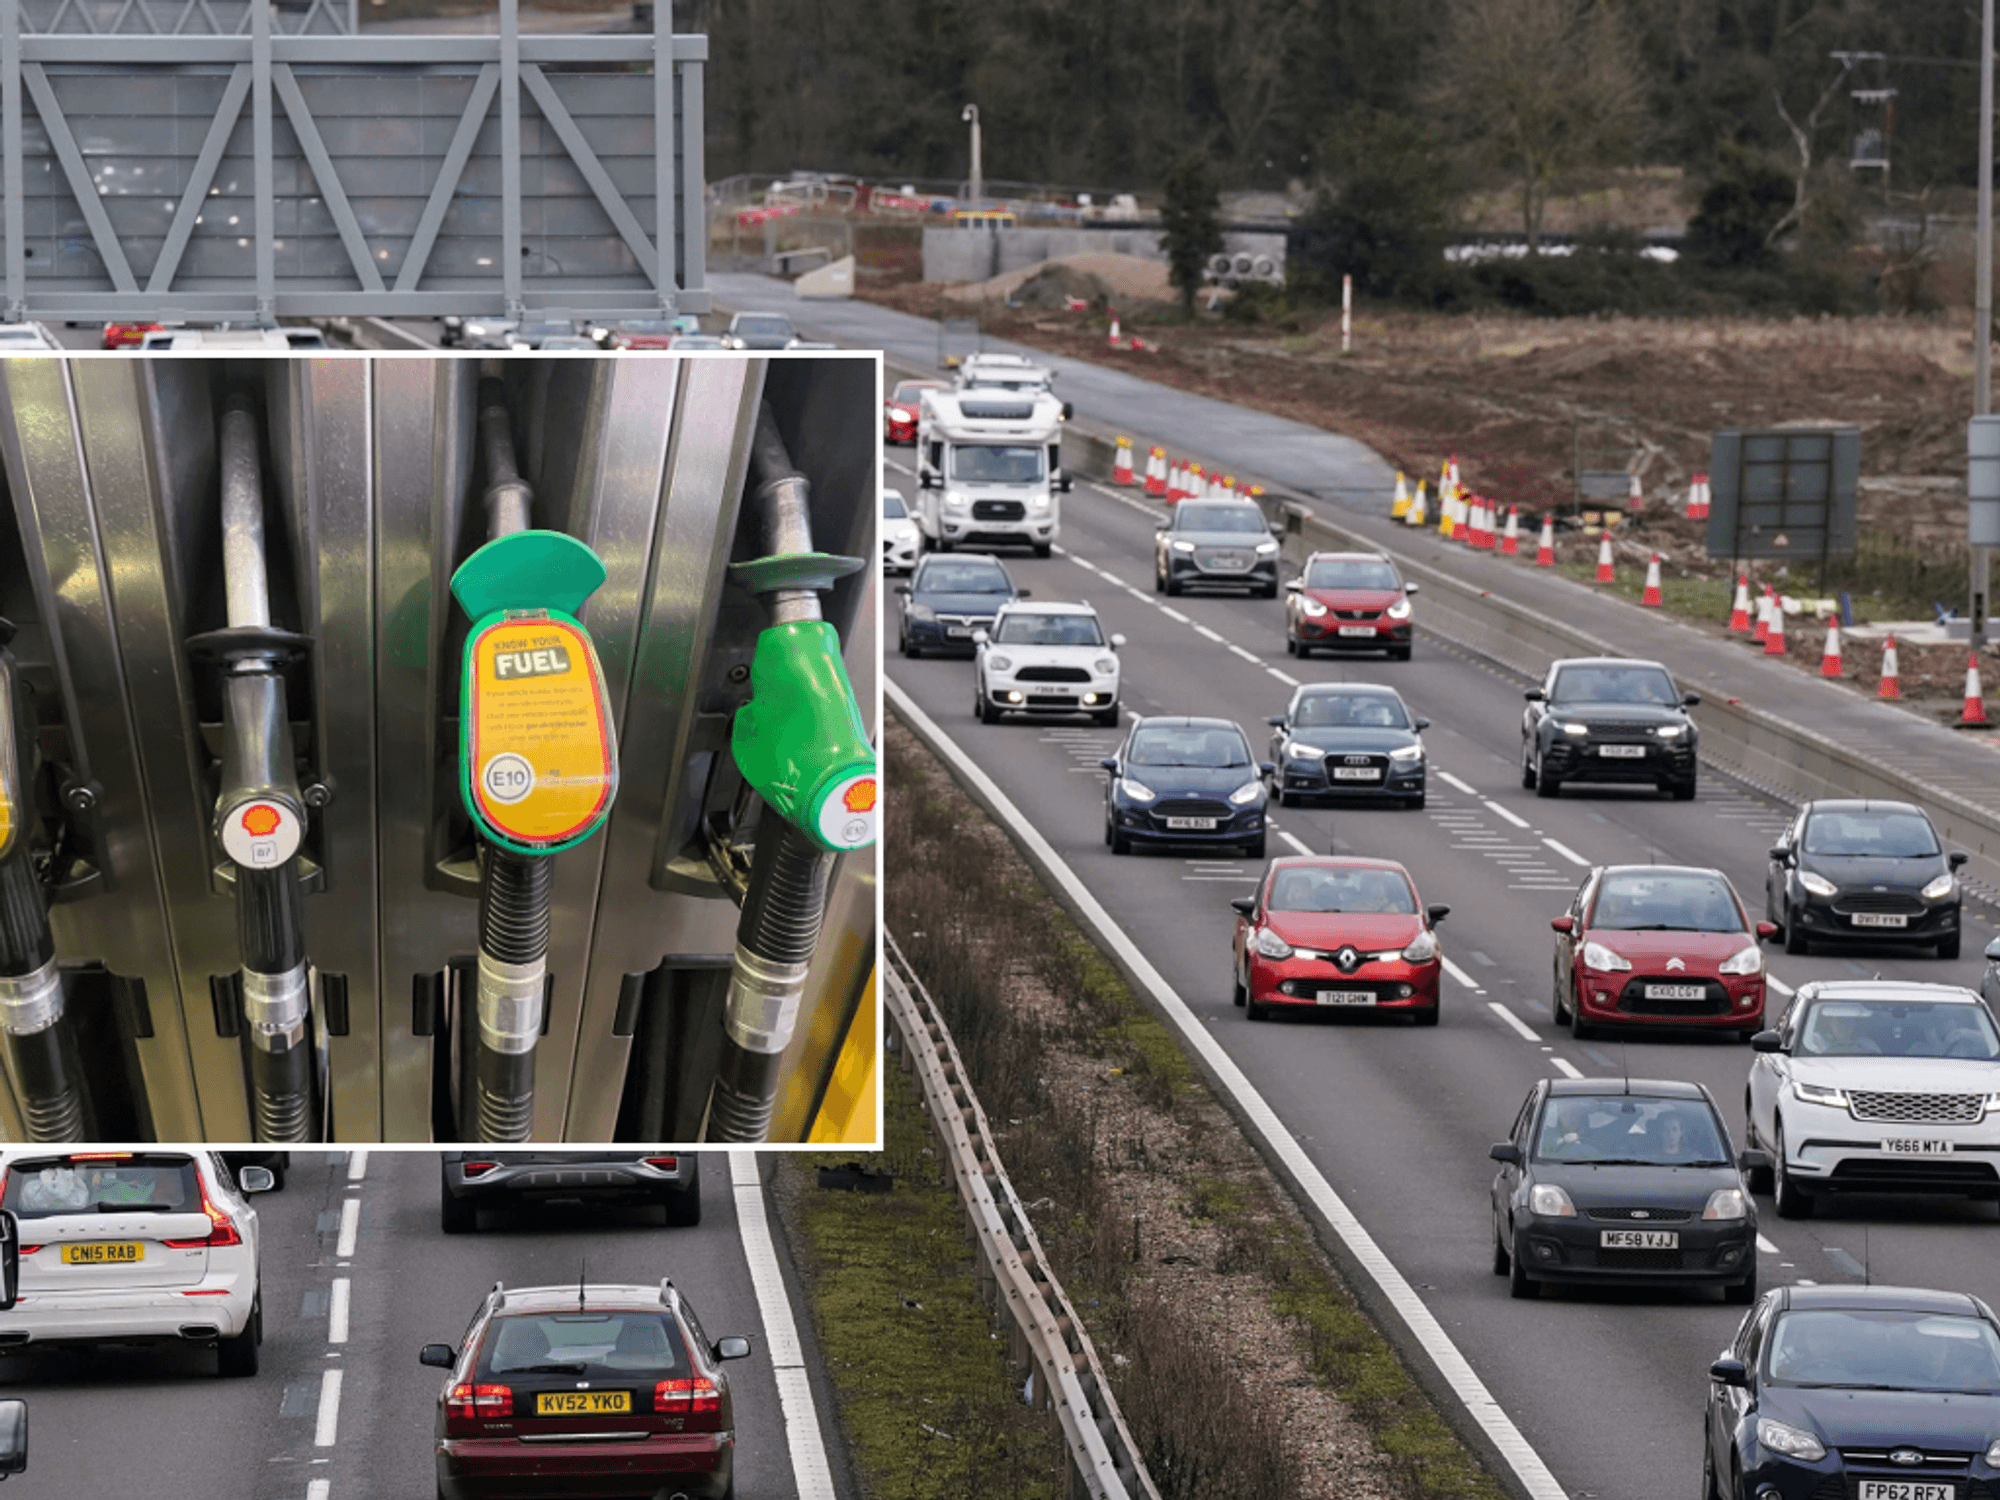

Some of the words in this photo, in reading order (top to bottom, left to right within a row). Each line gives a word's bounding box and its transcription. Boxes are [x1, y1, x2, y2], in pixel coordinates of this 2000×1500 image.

[496, 648, 567, 676] FUEL
[493, 770, 525, 786] E10
[1886, 1139, 1920, 1152] Y666
[1923, 1140, 1948, 1153] MTA
[1606, 1232, 1642, 1246] MF58
[1646, 1233, 1674, 1248] VJJ
[70, 1245, 103, 1261] CN15
[107, 1244, 137, 1259] RAB
[543, 1394, 587, 1411] KV52
[1865, 1482, 1910, 1500] FP62
